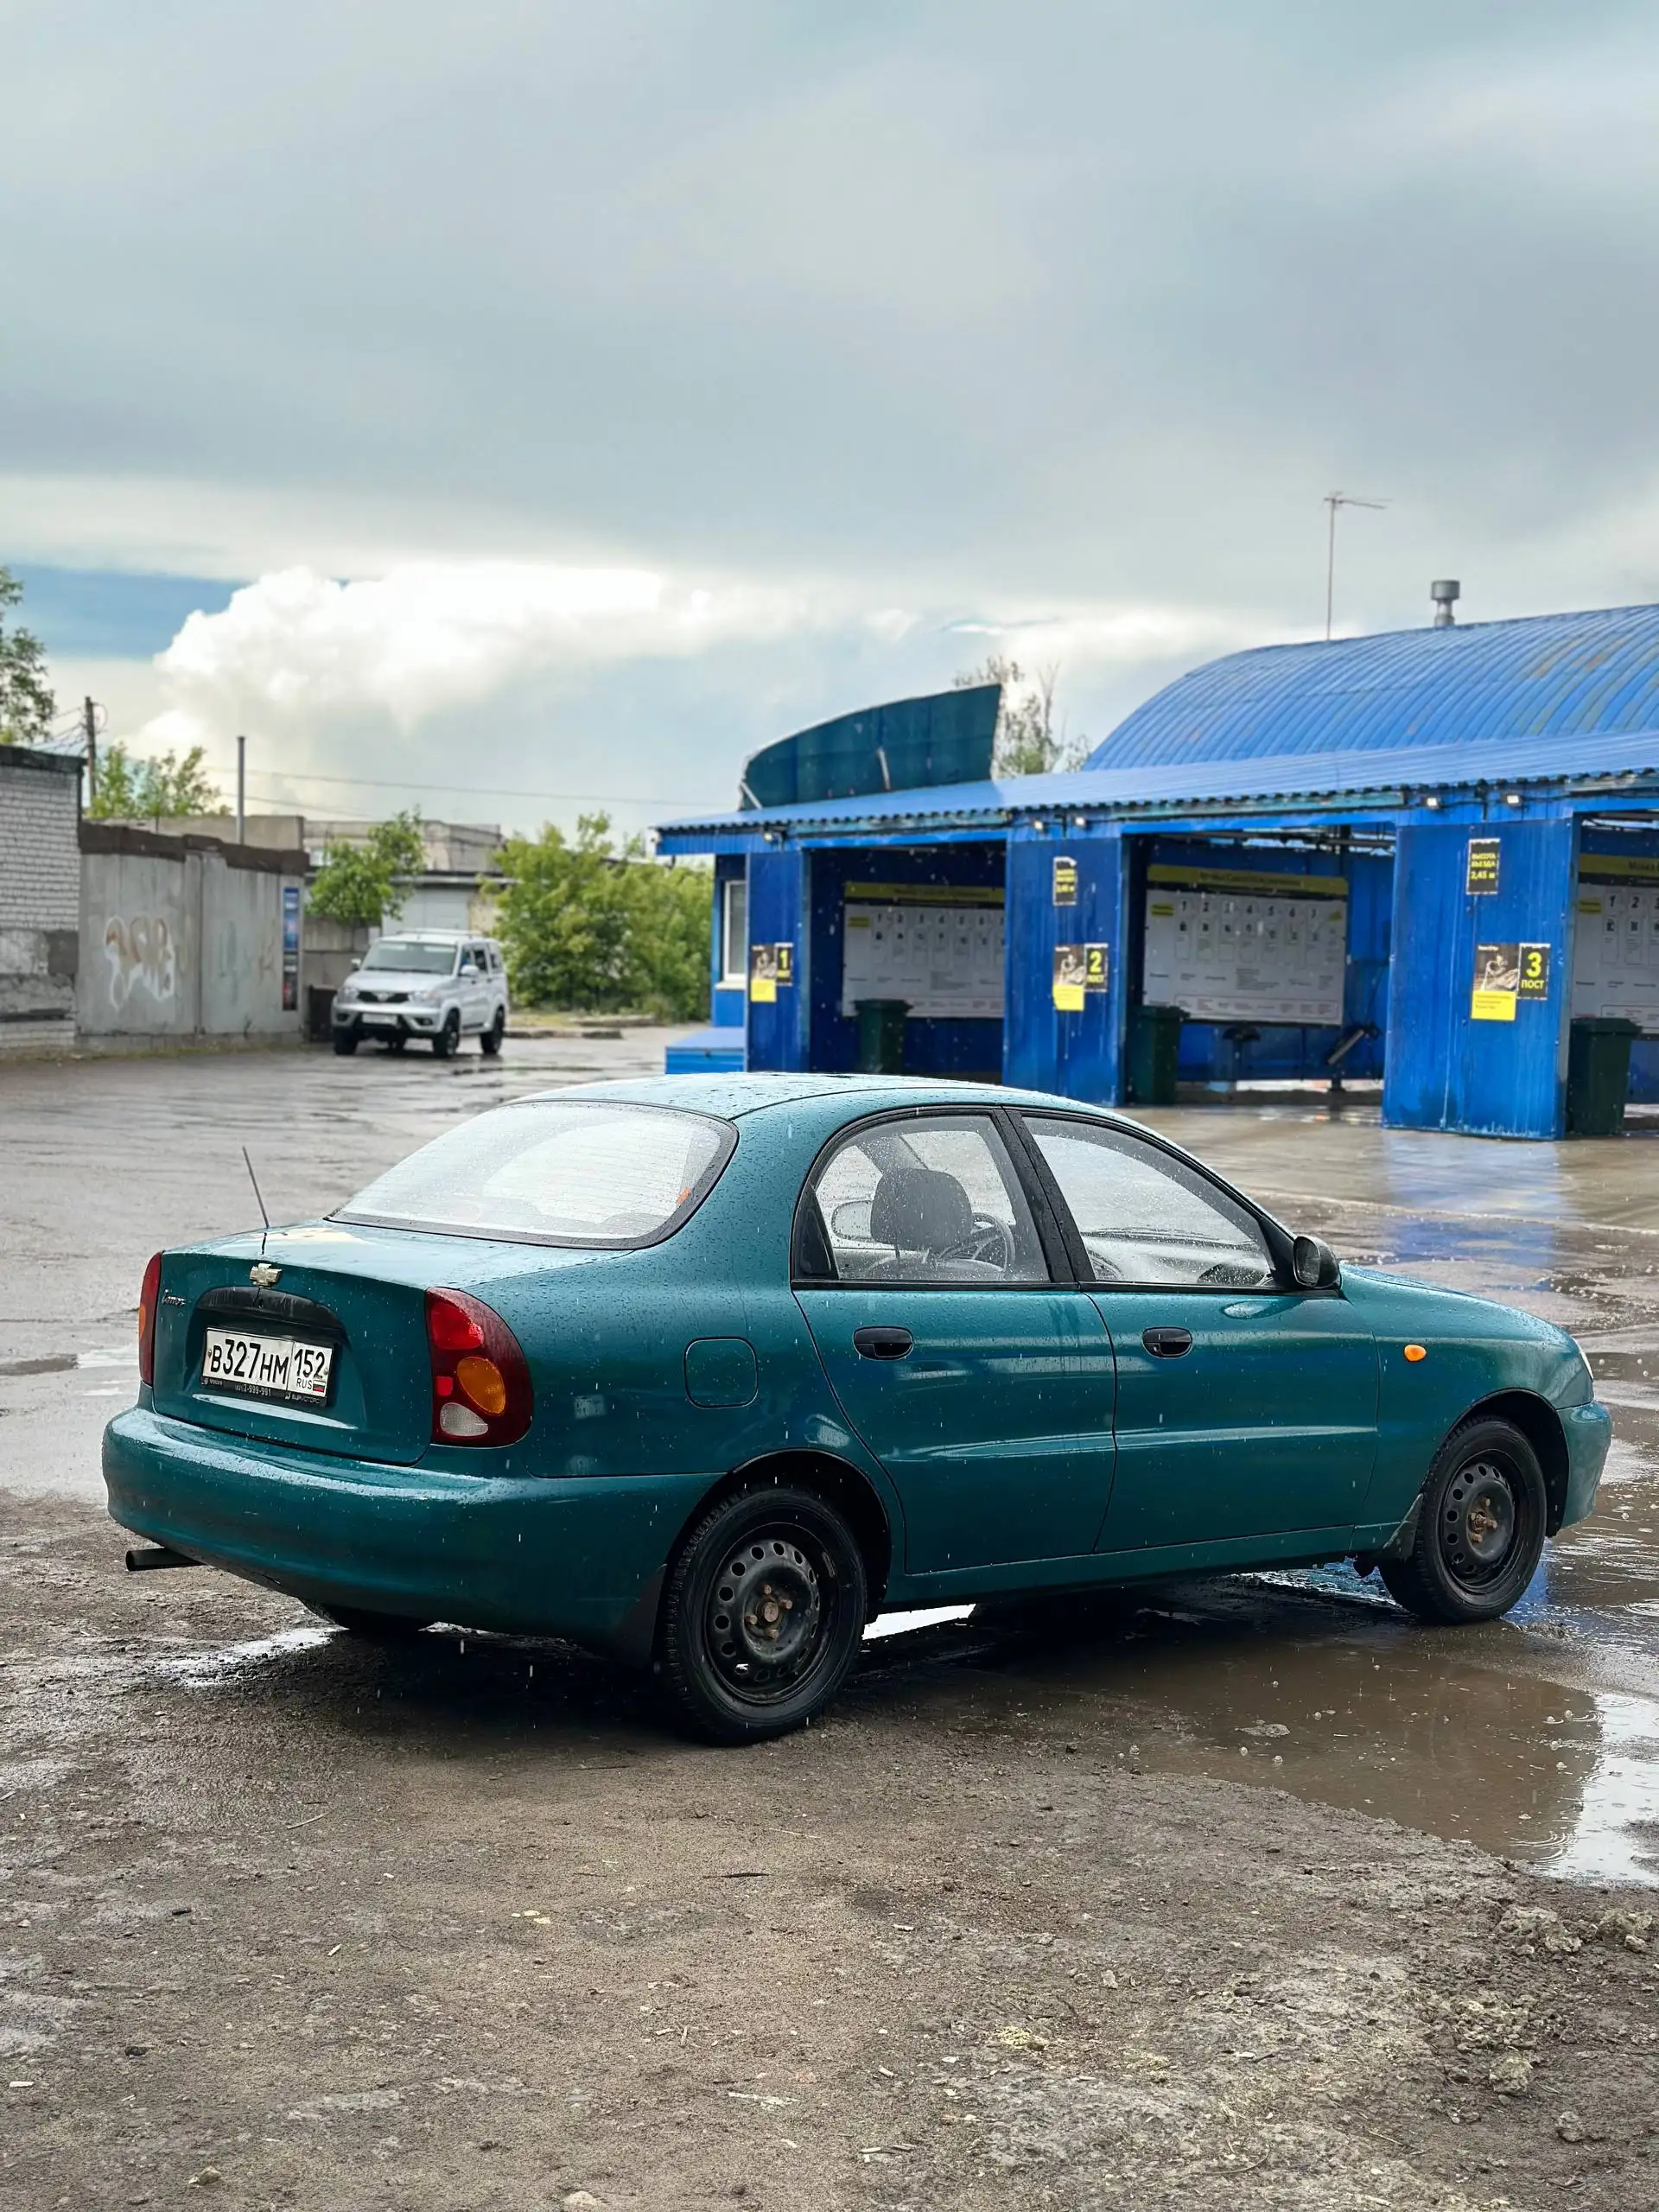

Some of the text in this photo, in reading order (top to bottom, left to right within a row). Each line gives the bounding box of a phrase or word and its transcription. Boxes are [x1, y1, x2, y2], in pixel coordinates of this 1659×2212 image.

[780, 949, 788, 969] 1
[1090, 950, 1102, 973] 2
[1526, 952, 1541, 978] 3
[1521, 979, 1544, 989] ПОСТ
[210, 1338, 325, 1384] В327НМ 152
[296, 1378, 313, 1389] RUS
